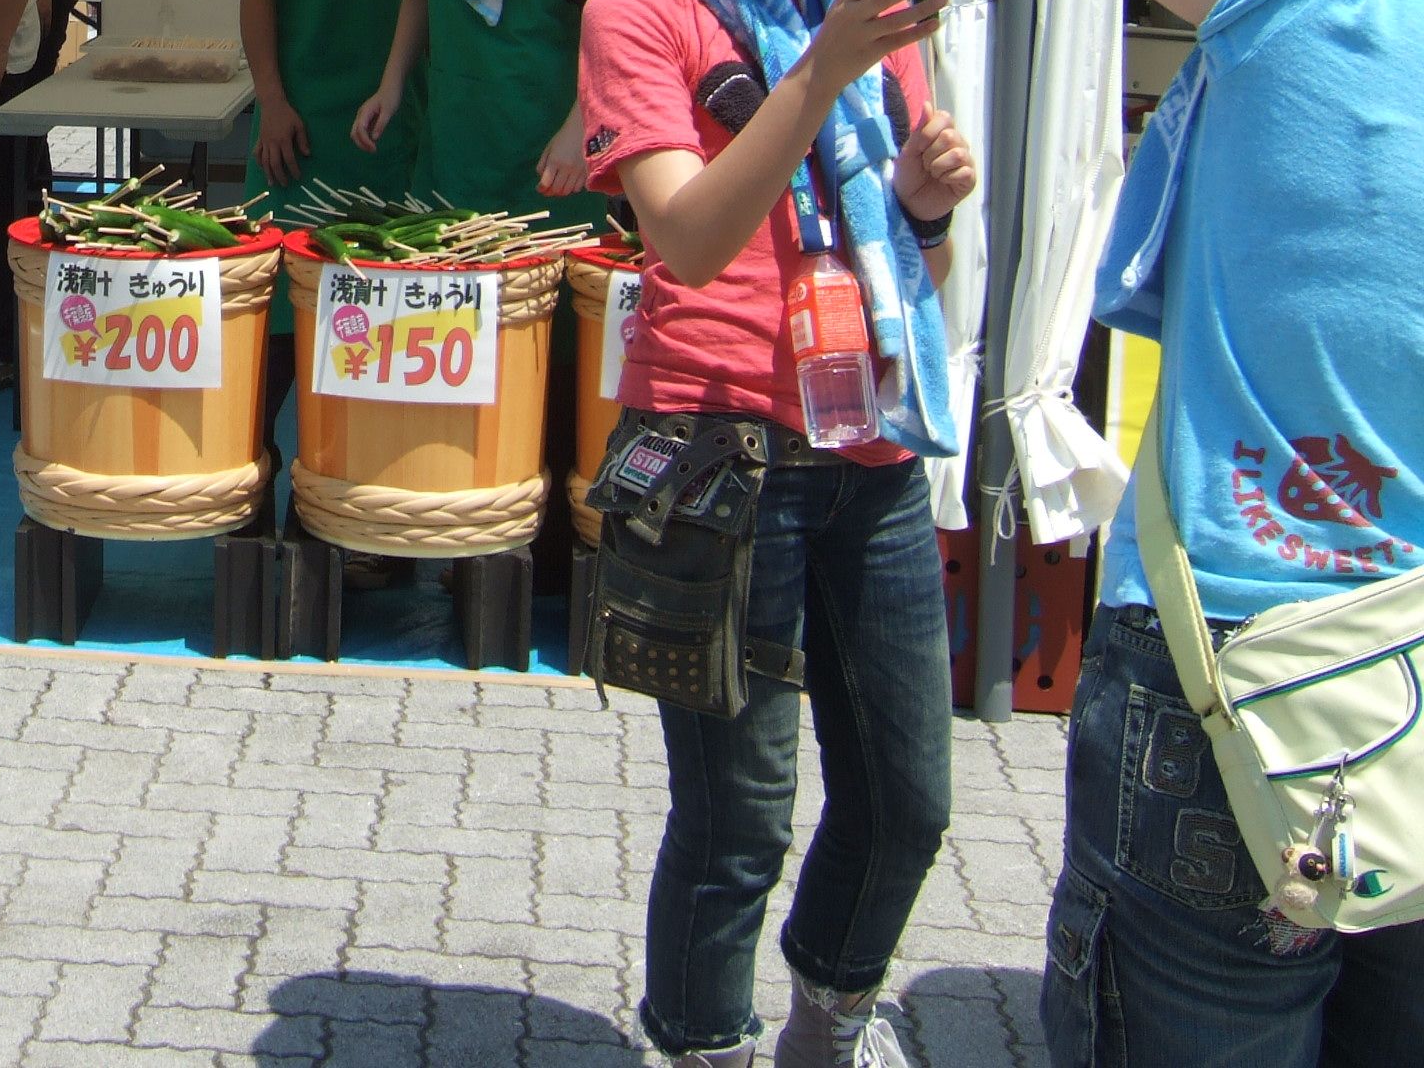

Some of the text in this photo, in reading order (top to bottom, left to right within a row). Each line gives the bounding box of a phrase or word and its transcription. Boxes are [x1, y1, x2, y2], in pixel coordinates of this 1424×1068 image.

[129, 270, 205, 298] きゅうり
[405, 281, 482, 310] きゅうり
[1231, 468, 1285, 546] LIKE
